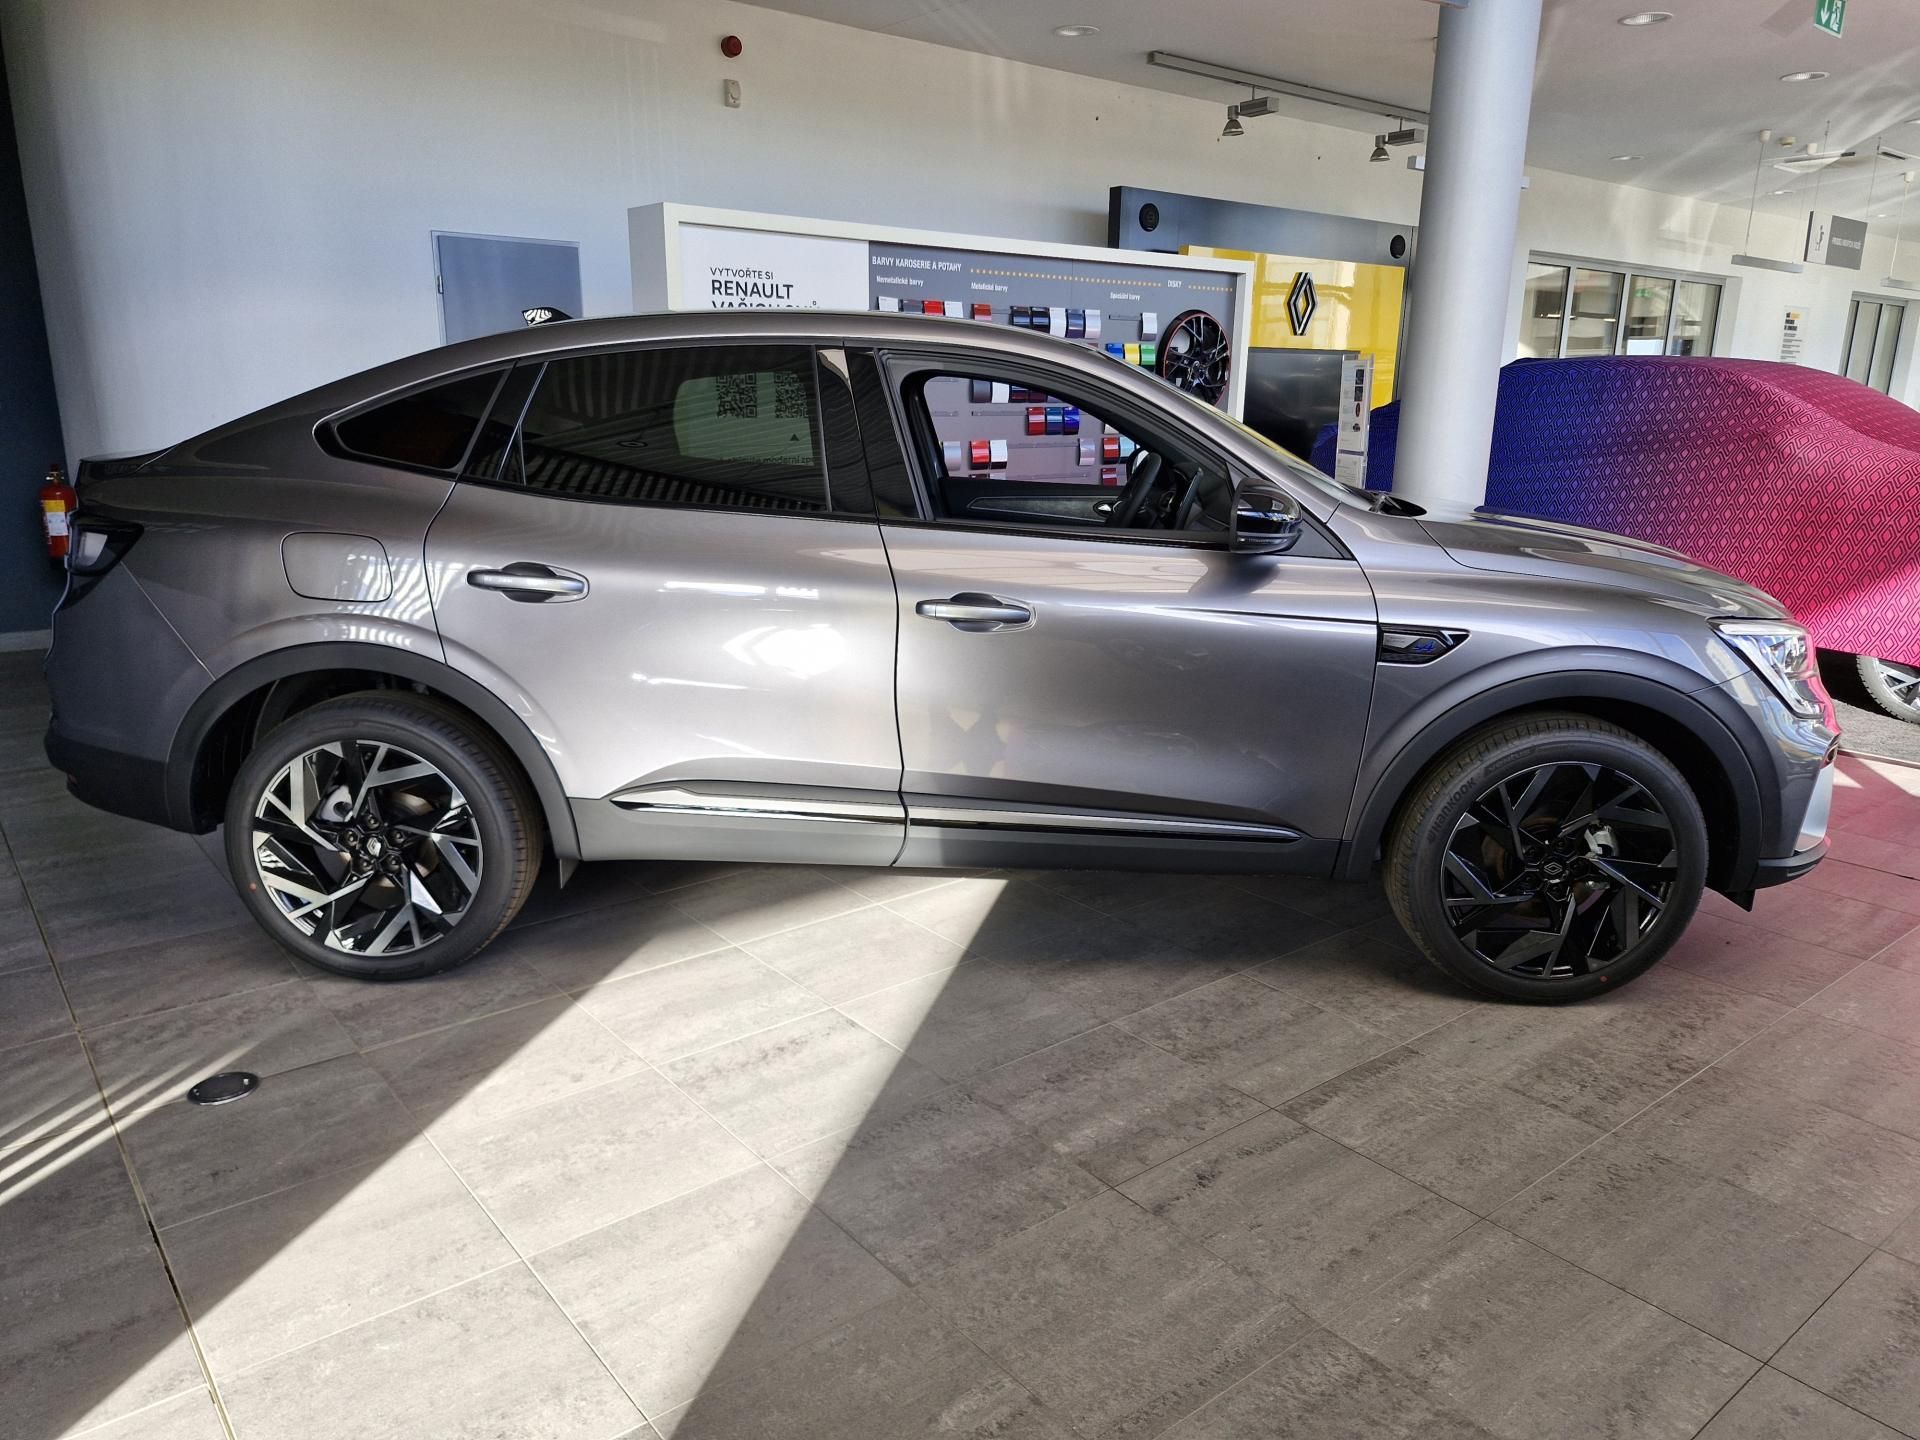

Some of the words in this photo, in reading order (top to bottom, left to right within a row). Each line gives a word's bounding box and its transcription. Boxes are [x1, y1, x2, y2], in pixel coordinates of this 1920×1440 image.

[872, 256, 894, 267] BARVY
[895, 258, 931, 270] KAROSERIE
[932, 261, 937, 270] A
[938, 261, 962, 273] POTAHY
[710, 267, 763, 279] VYTVOŘTE
[764, 271, 774, 281] SI
[711, 279, 794, 300] RENAULT
[909, 277, 924, 288] barvy
